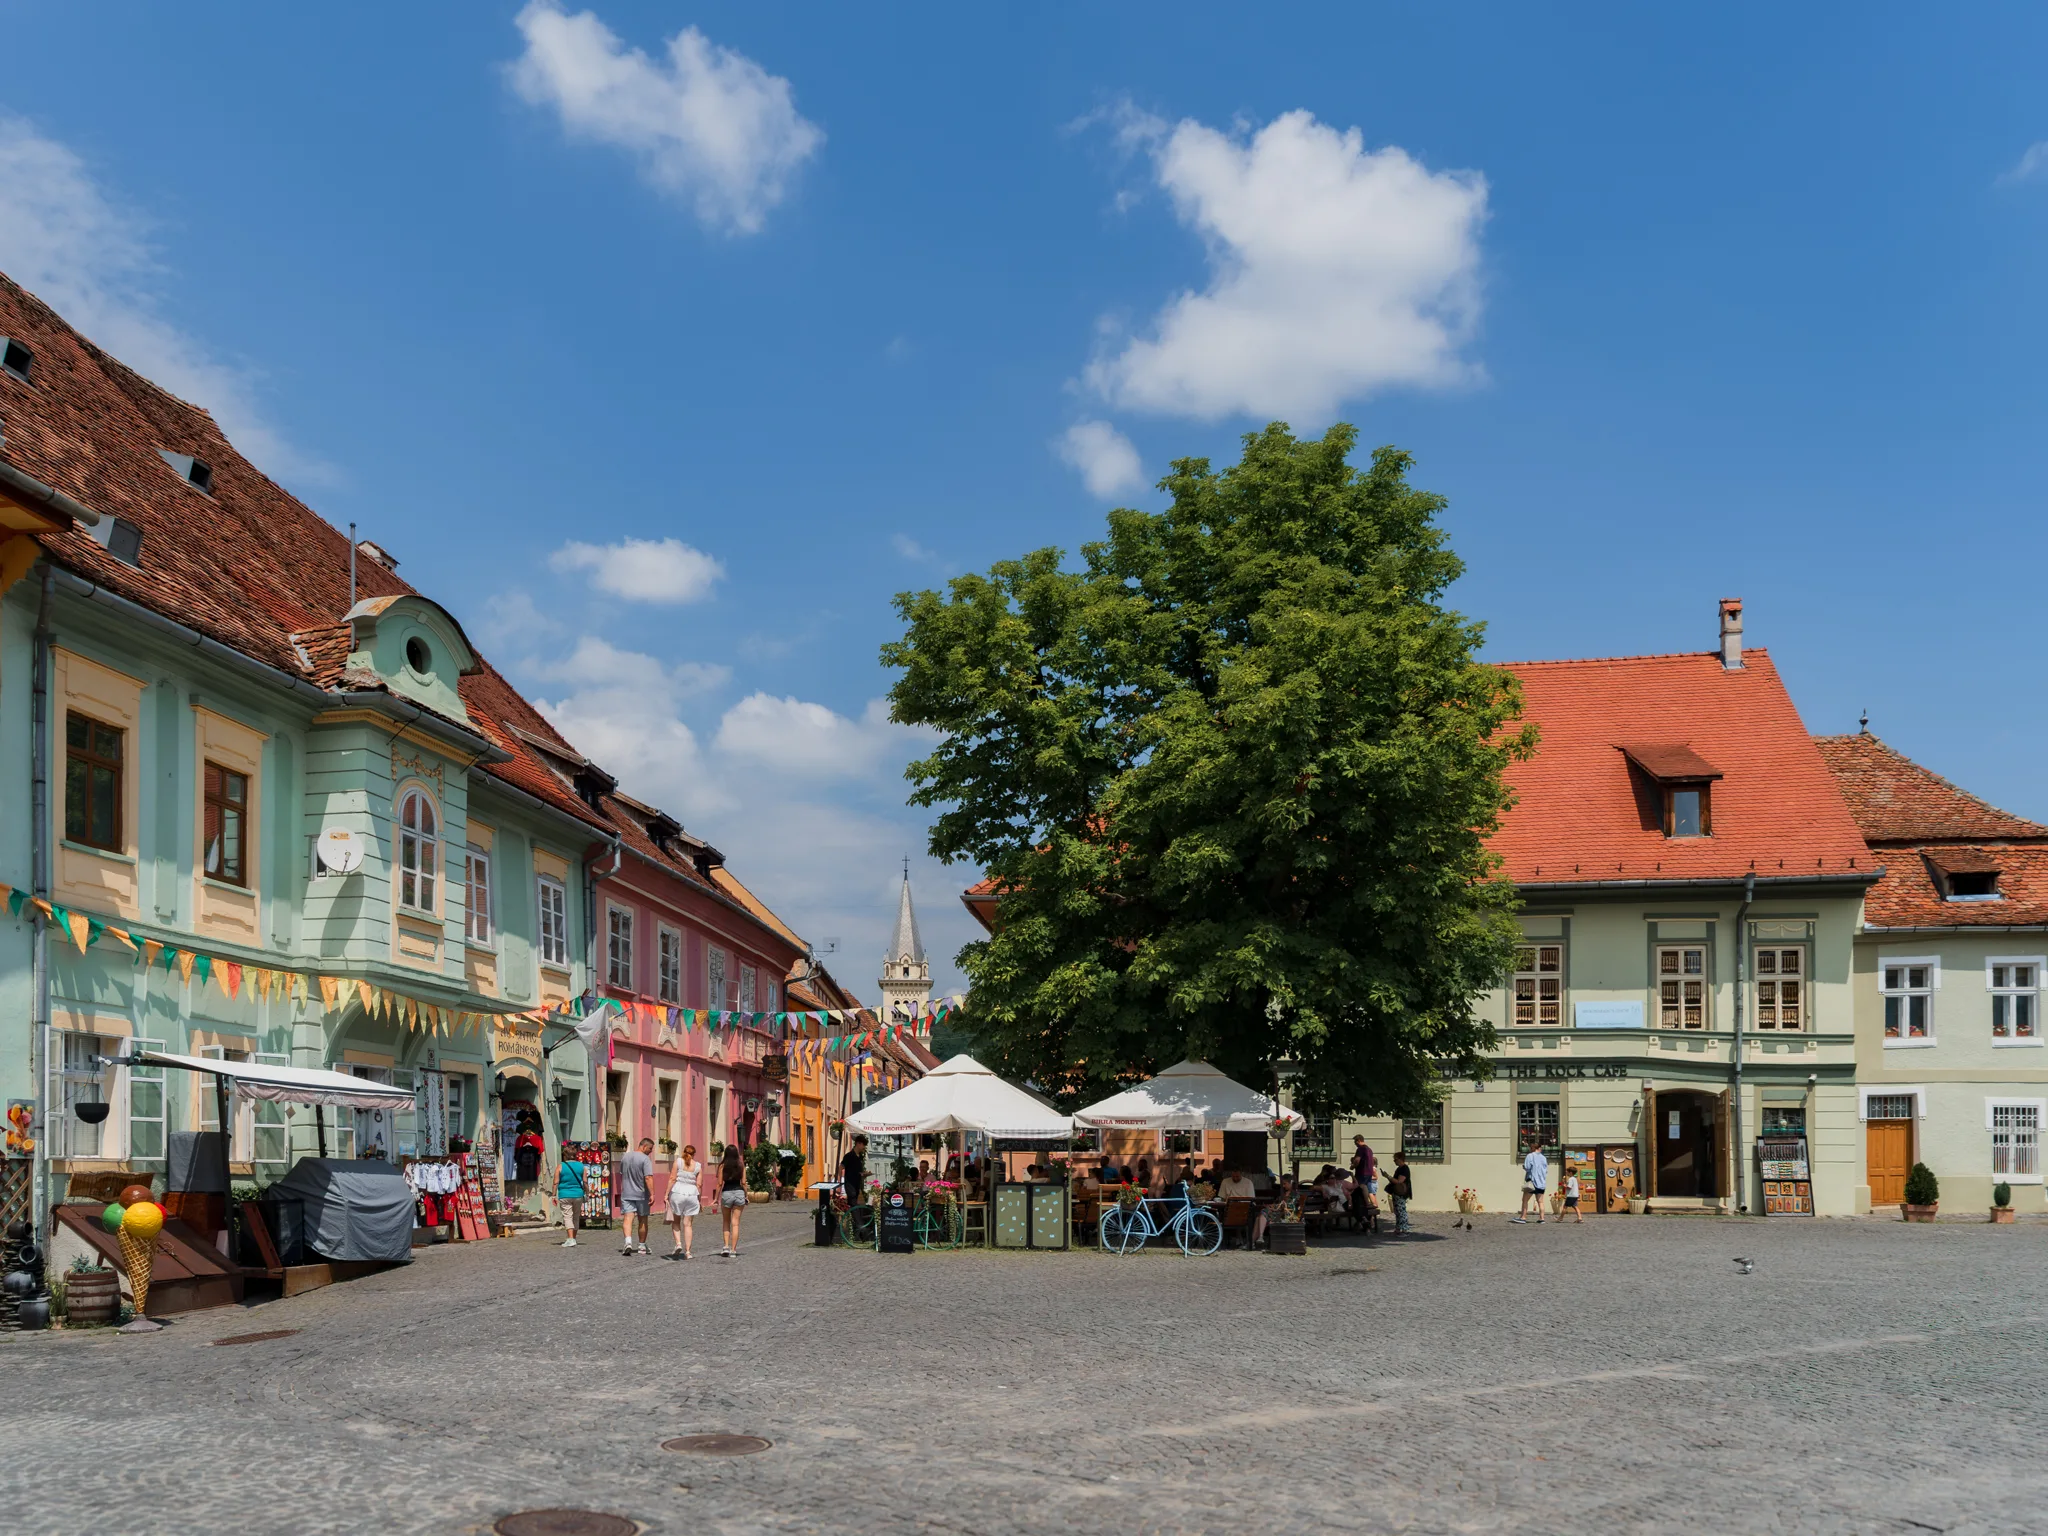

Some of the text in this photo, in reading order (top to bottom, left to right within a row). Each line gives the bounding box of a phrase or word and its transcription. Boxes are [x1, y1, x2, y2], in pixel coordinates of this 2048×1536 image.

[1506, 1065, 1537, 1078] THE
[1545, 1065, 1586, 1078] ROCK
[1593, 1064, 1629, 1078] CAFE
